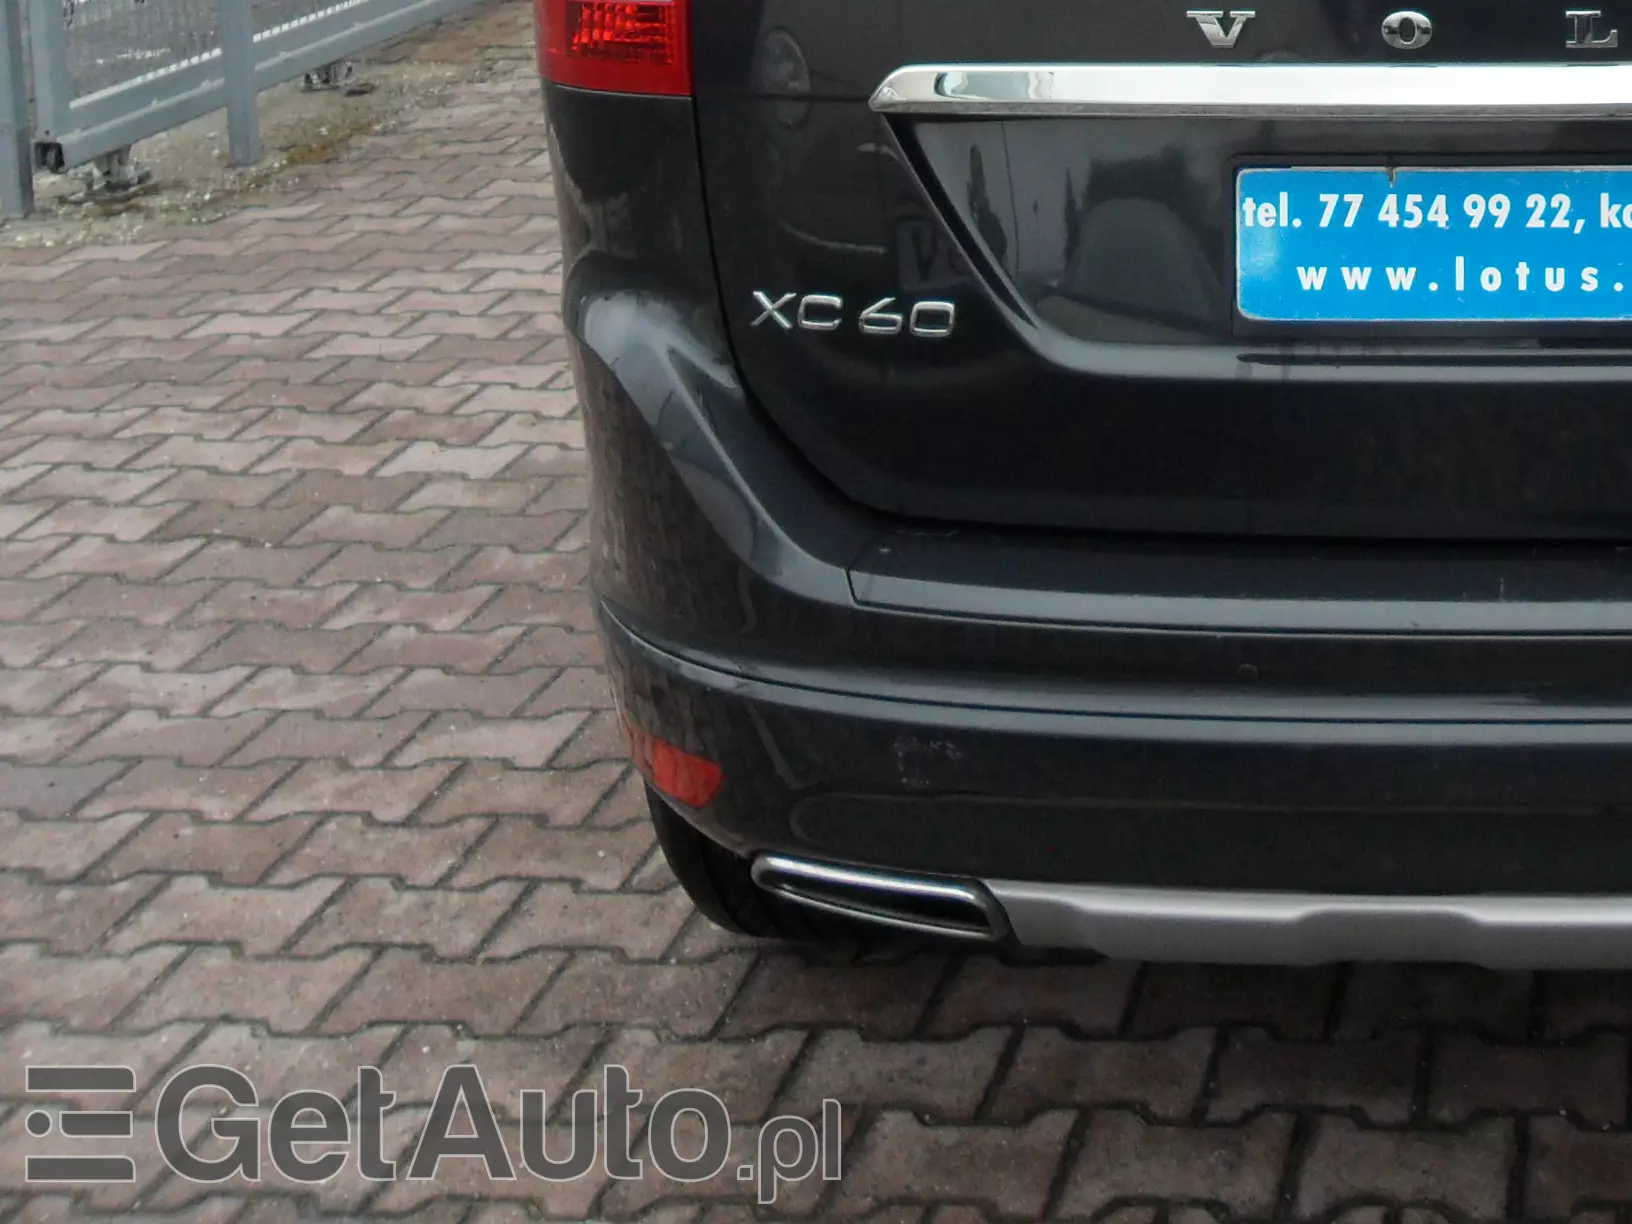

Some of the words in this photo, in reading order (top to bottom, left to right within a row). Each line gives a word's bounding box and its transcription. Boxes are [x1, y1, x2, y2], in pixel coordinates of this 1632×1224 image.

[1242, 192, 1302, 228] tel.
[1318, 193, 1364, 228] 77
[1377, 193, 1449, 228] 454
[1463, 193, 1510, 228] 99
[1525, 193, 1586, 234] 22,
